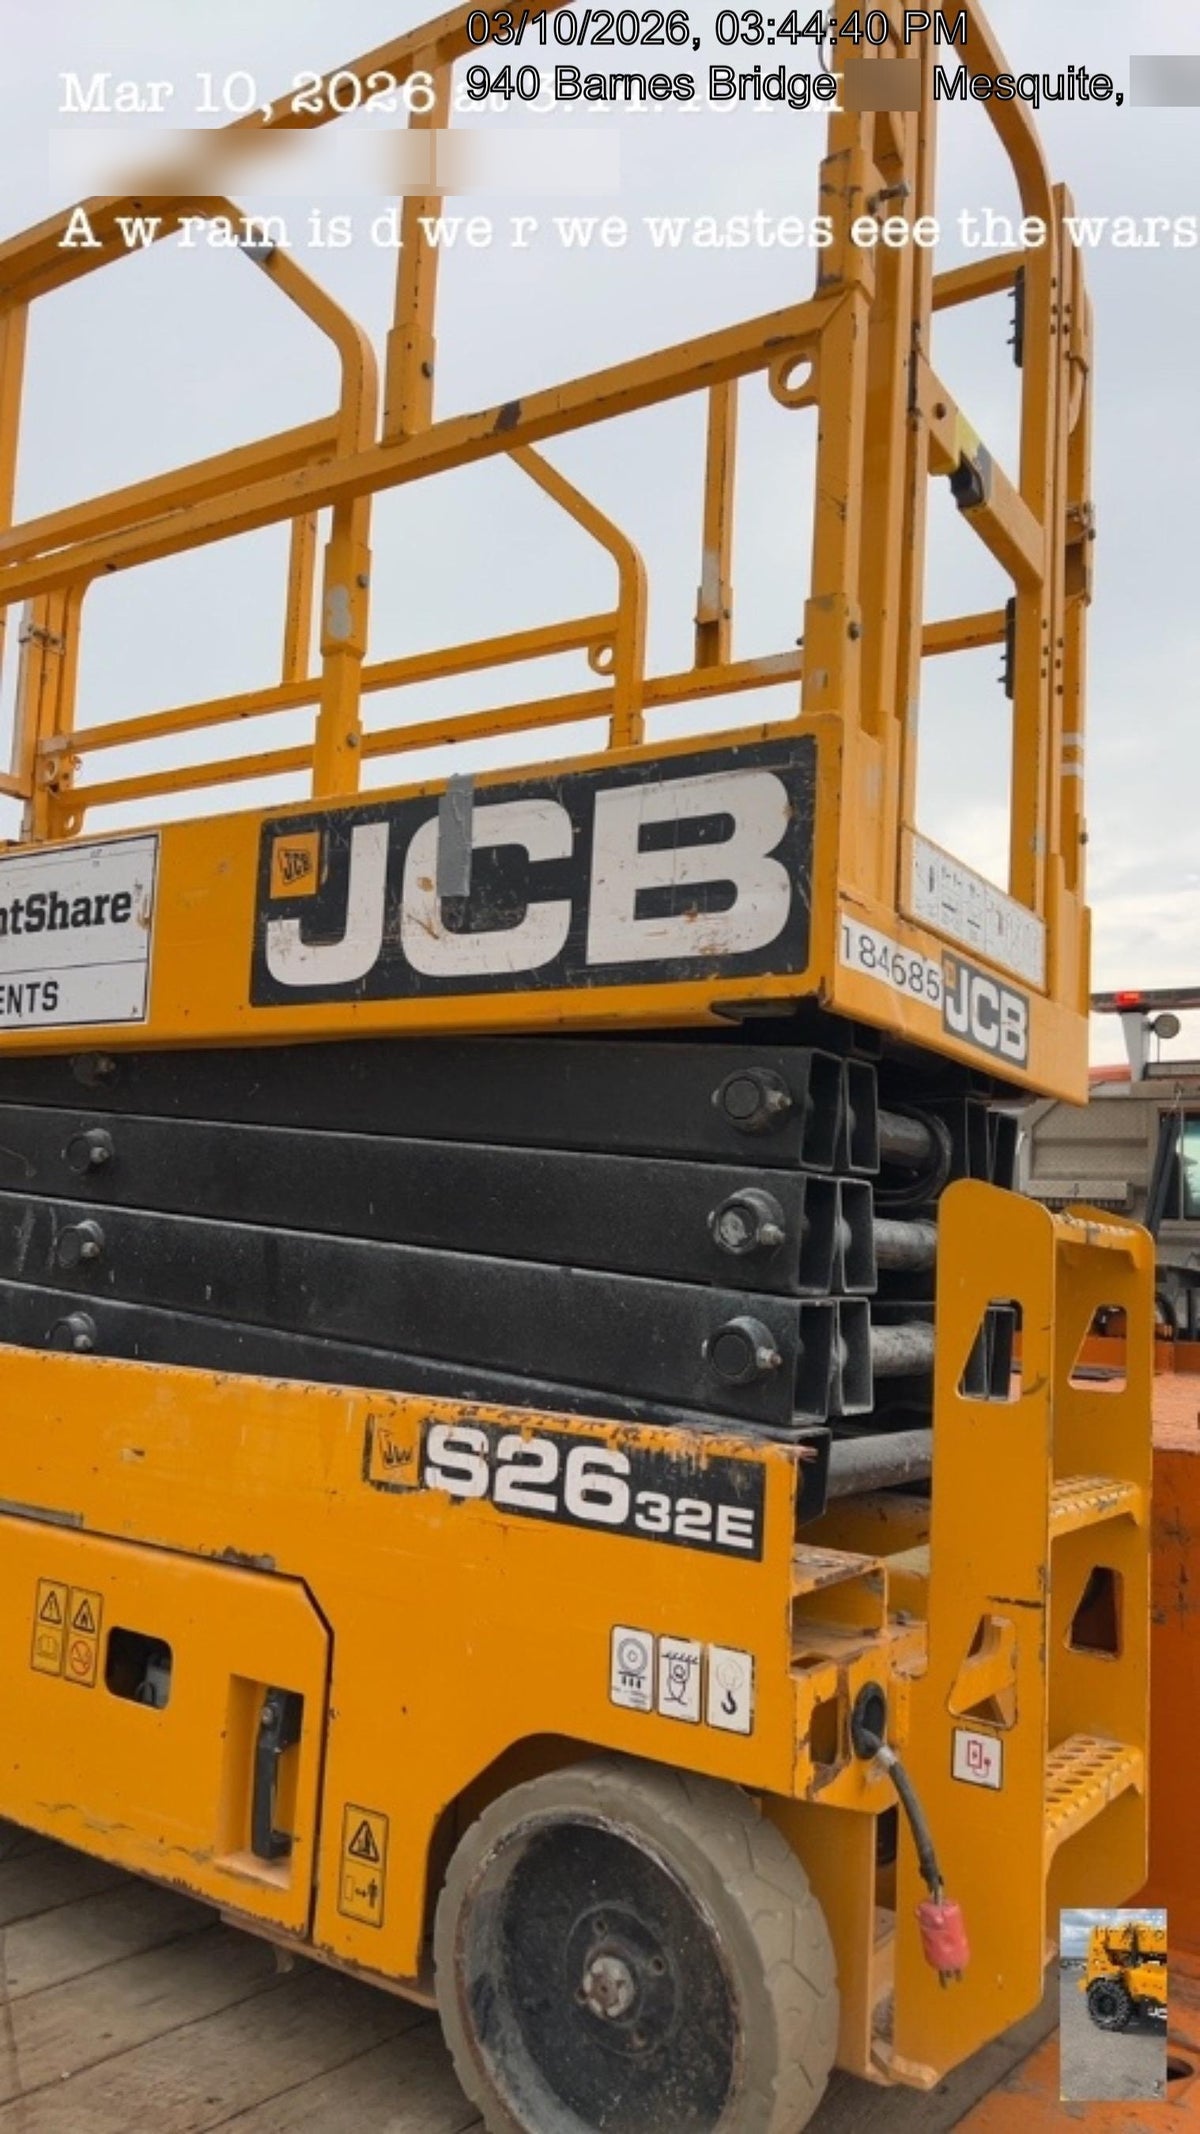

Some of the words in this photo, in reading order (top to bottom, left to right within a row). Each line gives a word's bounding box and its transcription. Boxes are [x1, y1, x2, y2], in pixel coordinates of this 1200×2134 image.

[266, 771, 792, 987] JCB
[842, 926, 941, 1001] 184685
[945, 966, 1026, 1061] JCB
